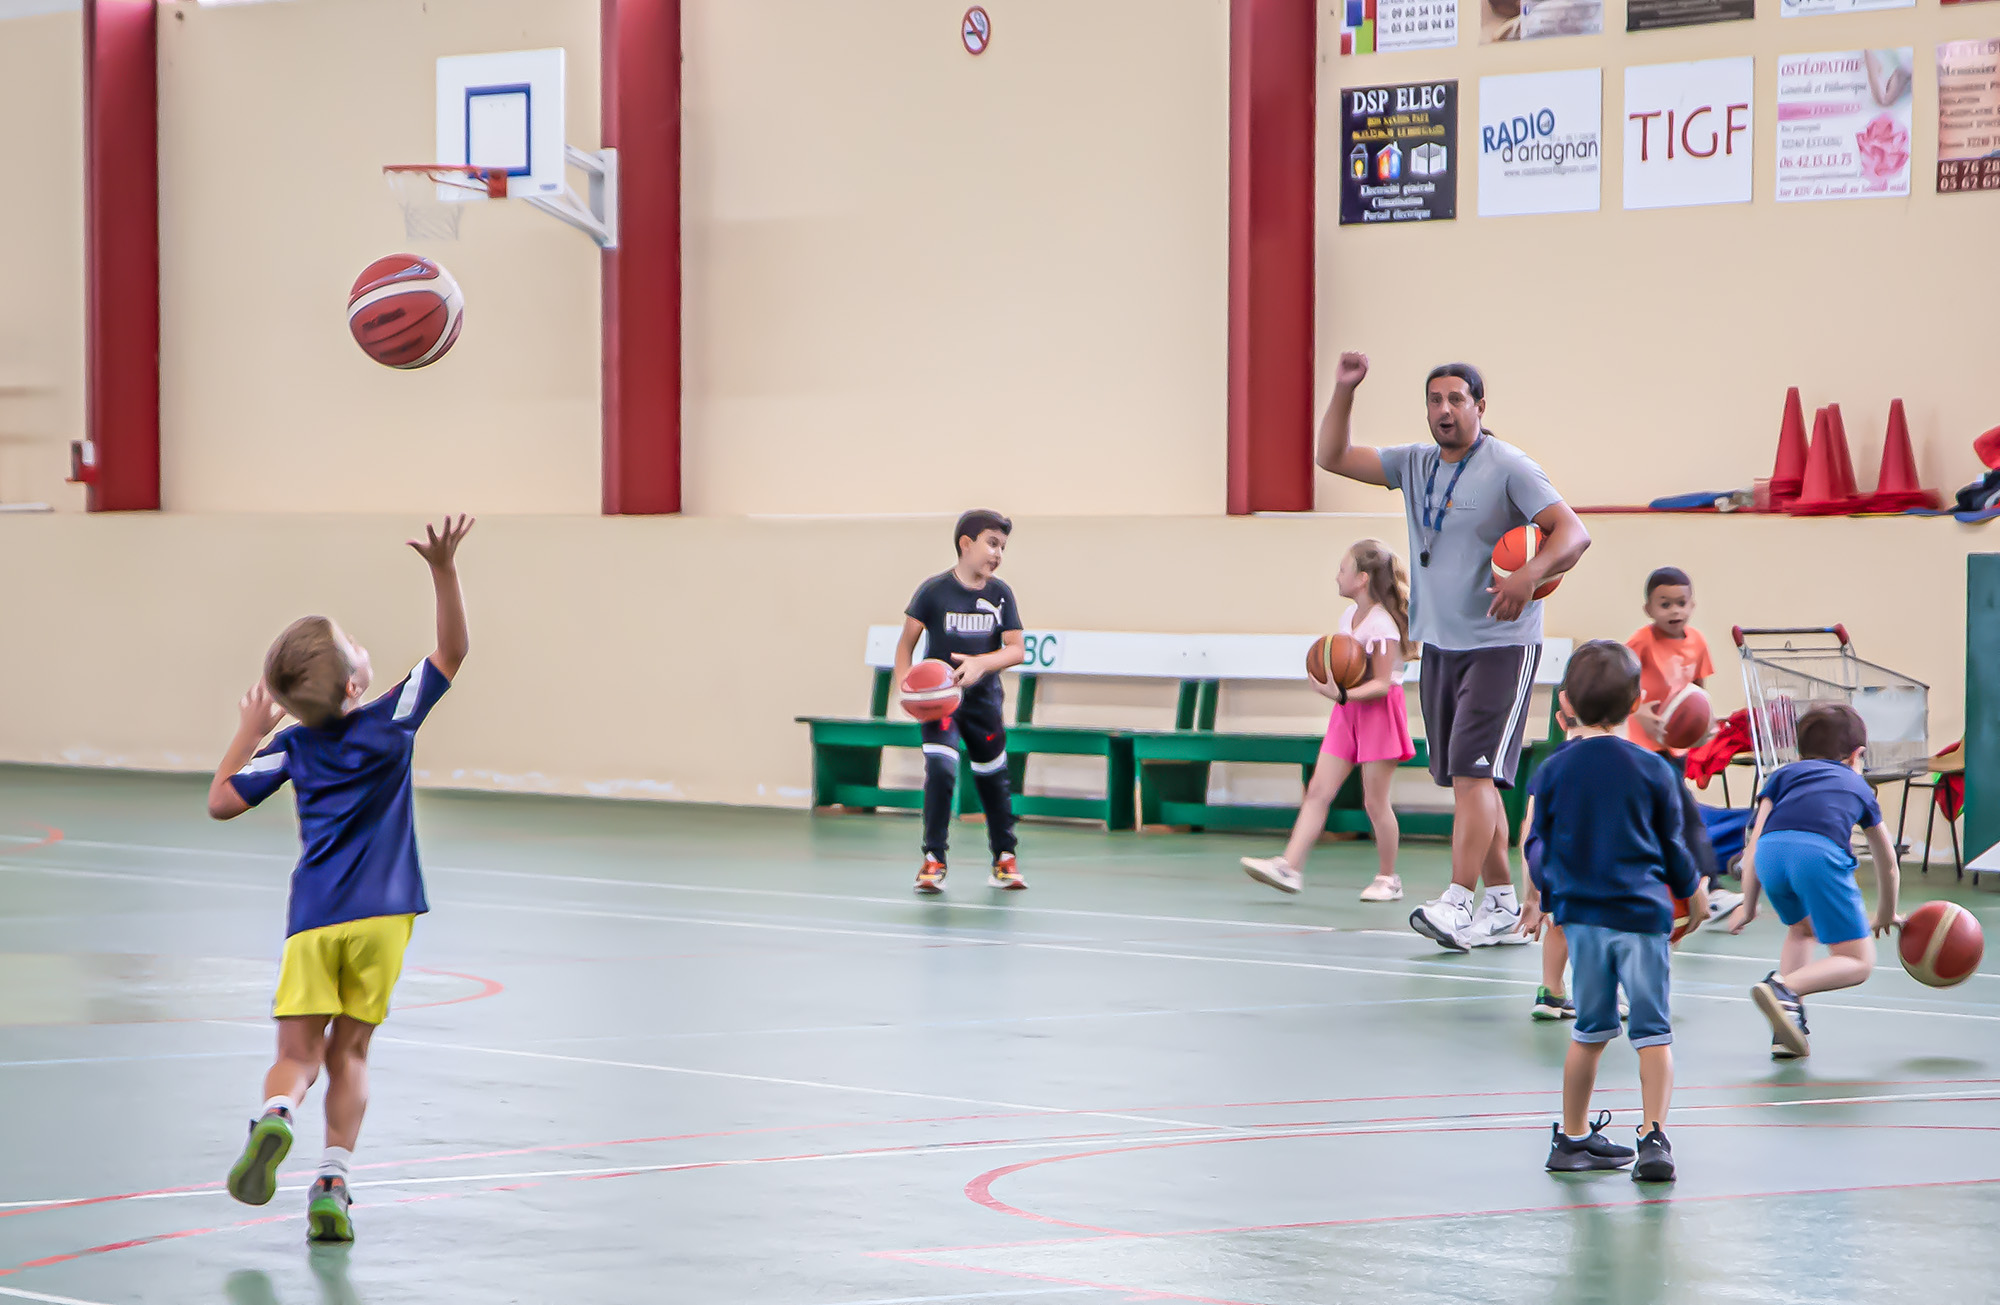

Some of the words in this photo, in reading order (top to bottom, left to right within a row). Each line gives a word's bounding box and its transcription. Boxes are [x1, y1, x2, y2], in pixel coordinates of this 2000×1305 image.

[1352, 89, 1389, 115] DSP
[1396, 84, 1446, 112] ELEC
[1482, 107, 1555, 153] RADIO
[1629, 103, 1748, 161] TIGF
[945, 612, 995, 632] PUMA
